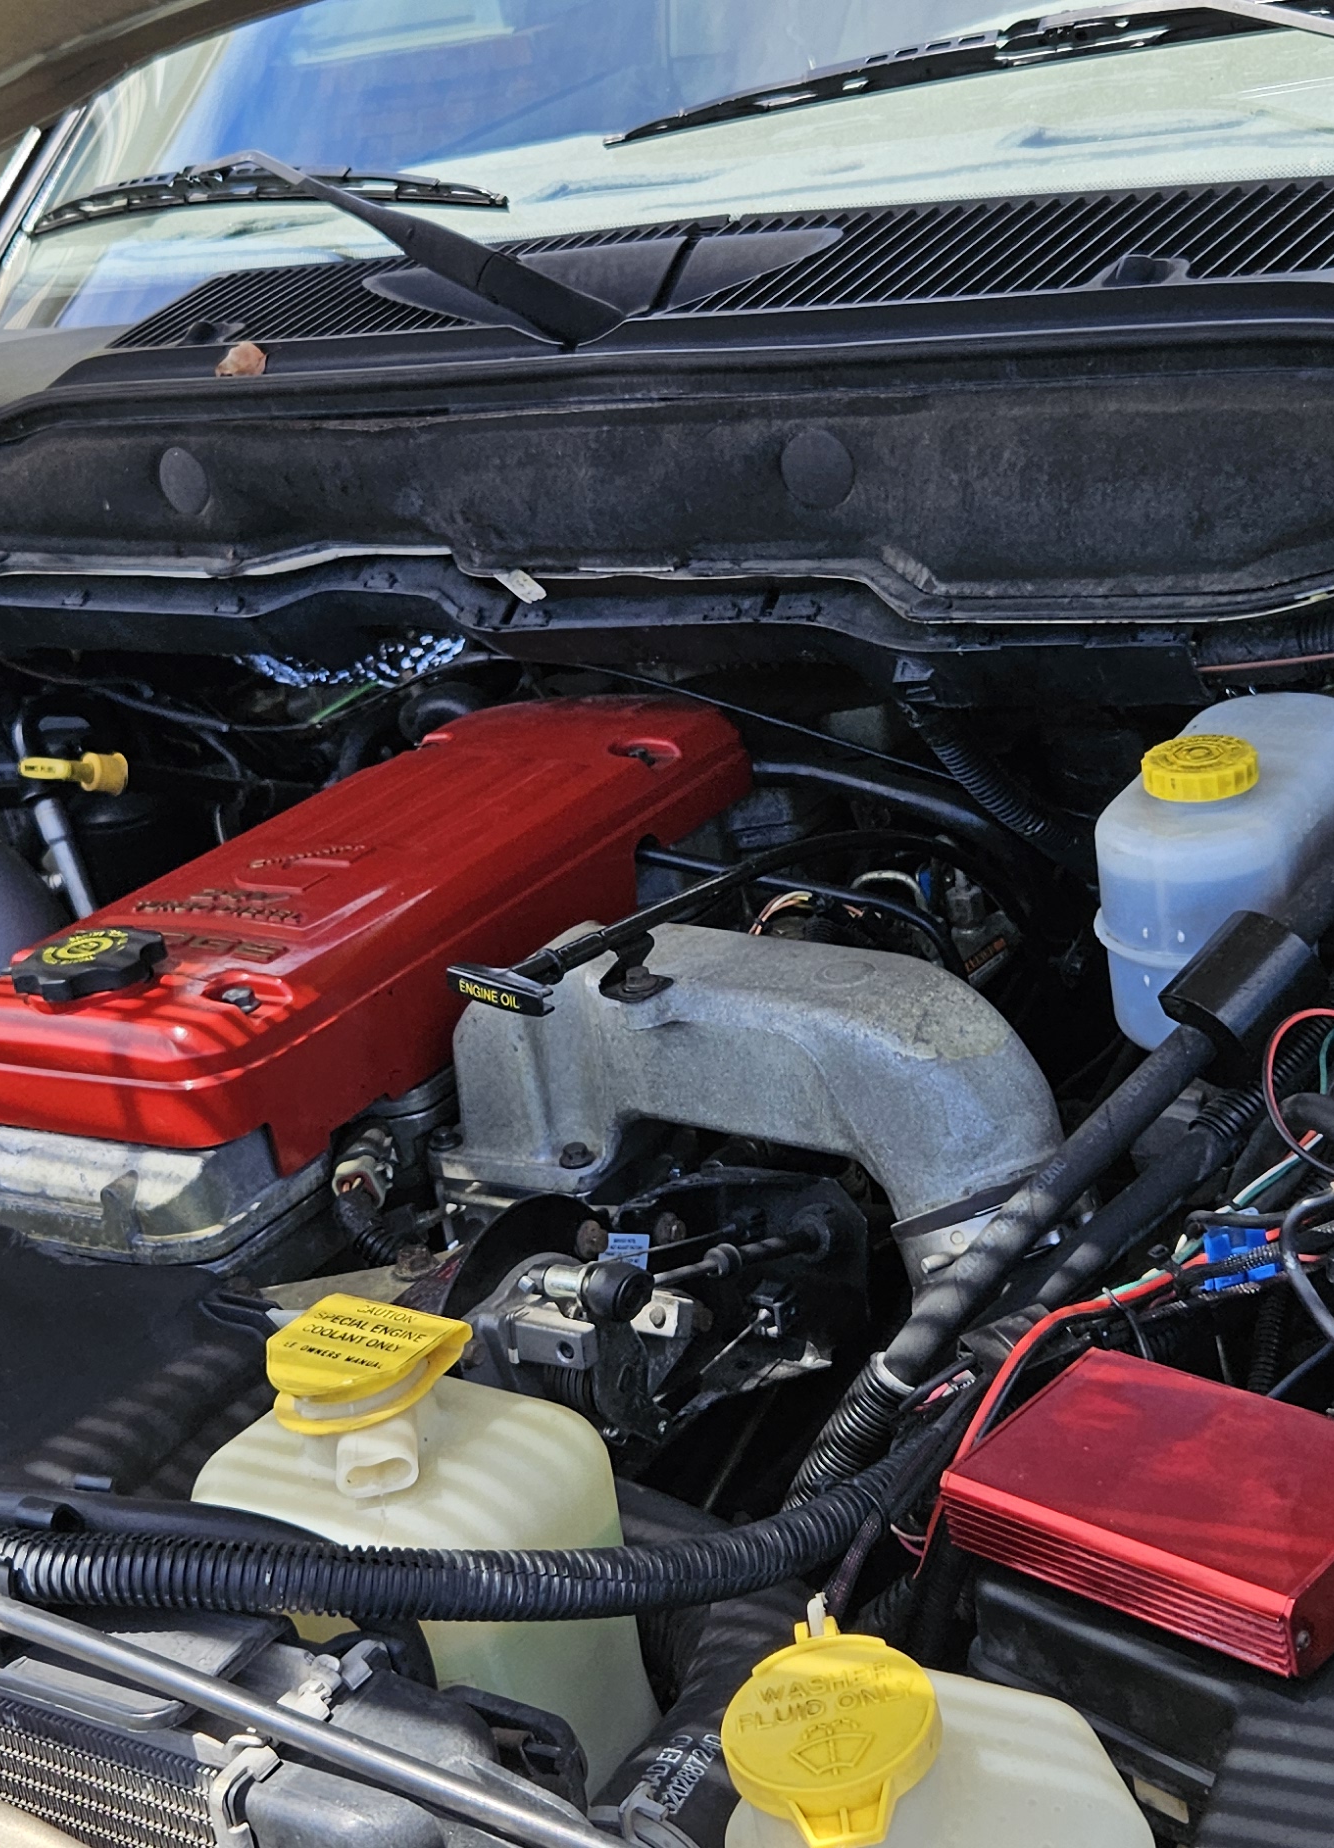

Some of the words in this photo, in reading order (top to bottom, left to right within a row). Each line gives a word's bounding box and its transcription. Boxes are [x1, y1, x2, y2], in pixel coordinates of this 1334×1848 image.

[459, 978, 499, 1004] ENGINE
[500, 992, 521, 1010] OIL
[314, 1311, 368, 1331] SPECIAL
[371, 1324, 427, 1343] ENGINE
[356, 1304, 417, 1324] CAUTION
[302, 1323, 365, 1346] COOLANT
[366, 1337, 404, 1353] ONLY
[300, 1344, 340, 1360] OWNERS
[344, 1355, 384, 1370] MANUAL
[758, 1662, 892, 1706] WASHER
[736, 1699, 827, 1735] FLUID
[834, 1678, 916, 1712] ONLY
